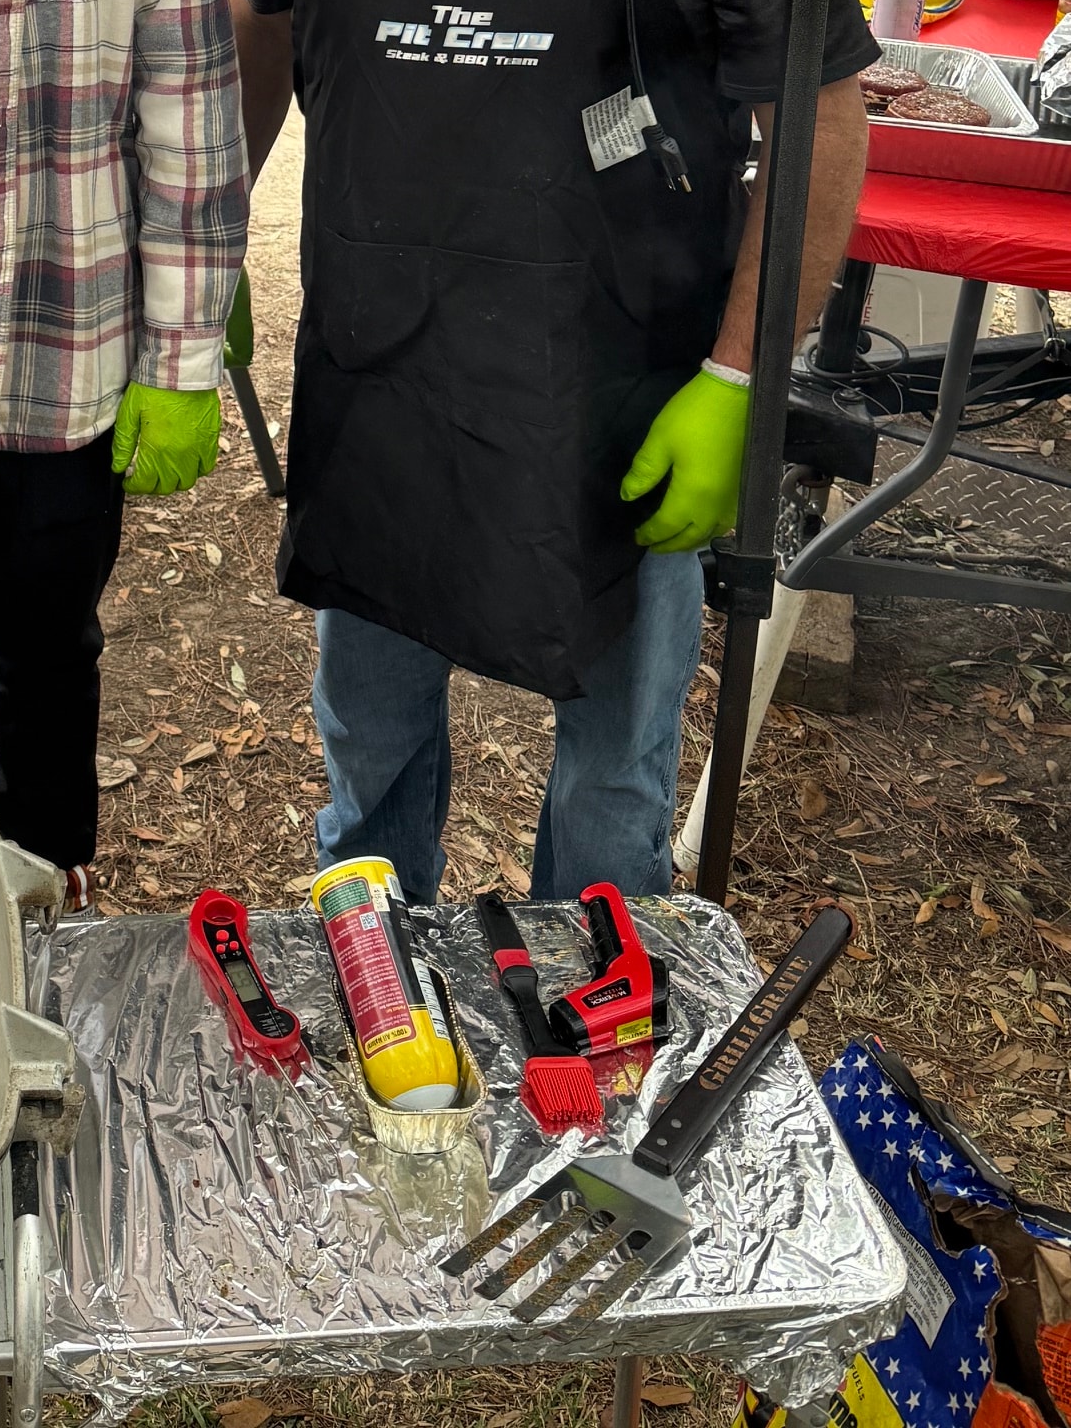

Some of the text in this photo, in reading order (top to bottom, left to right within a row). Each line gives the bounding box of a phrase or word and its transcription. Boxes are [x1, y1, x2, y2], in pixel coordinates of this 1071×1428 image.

[431, 4, 495, 27] The
[374, 20, 556, 52] Pit Crew
[385, 48, 540, 67] Steak & BBQ Team
[591, 990, 628, 1006] MAVERICK
[391, 1027, 407, 1037] 100%
[699, 955, 813, 1091] GRILLGRATE
[382, 1033, 390, 1041] All
[618, 1029, 649, 1043] CAUTION
[891, 1217, 916, 1246] CARBON
[849, 1364, 866, 1402] FUELS
